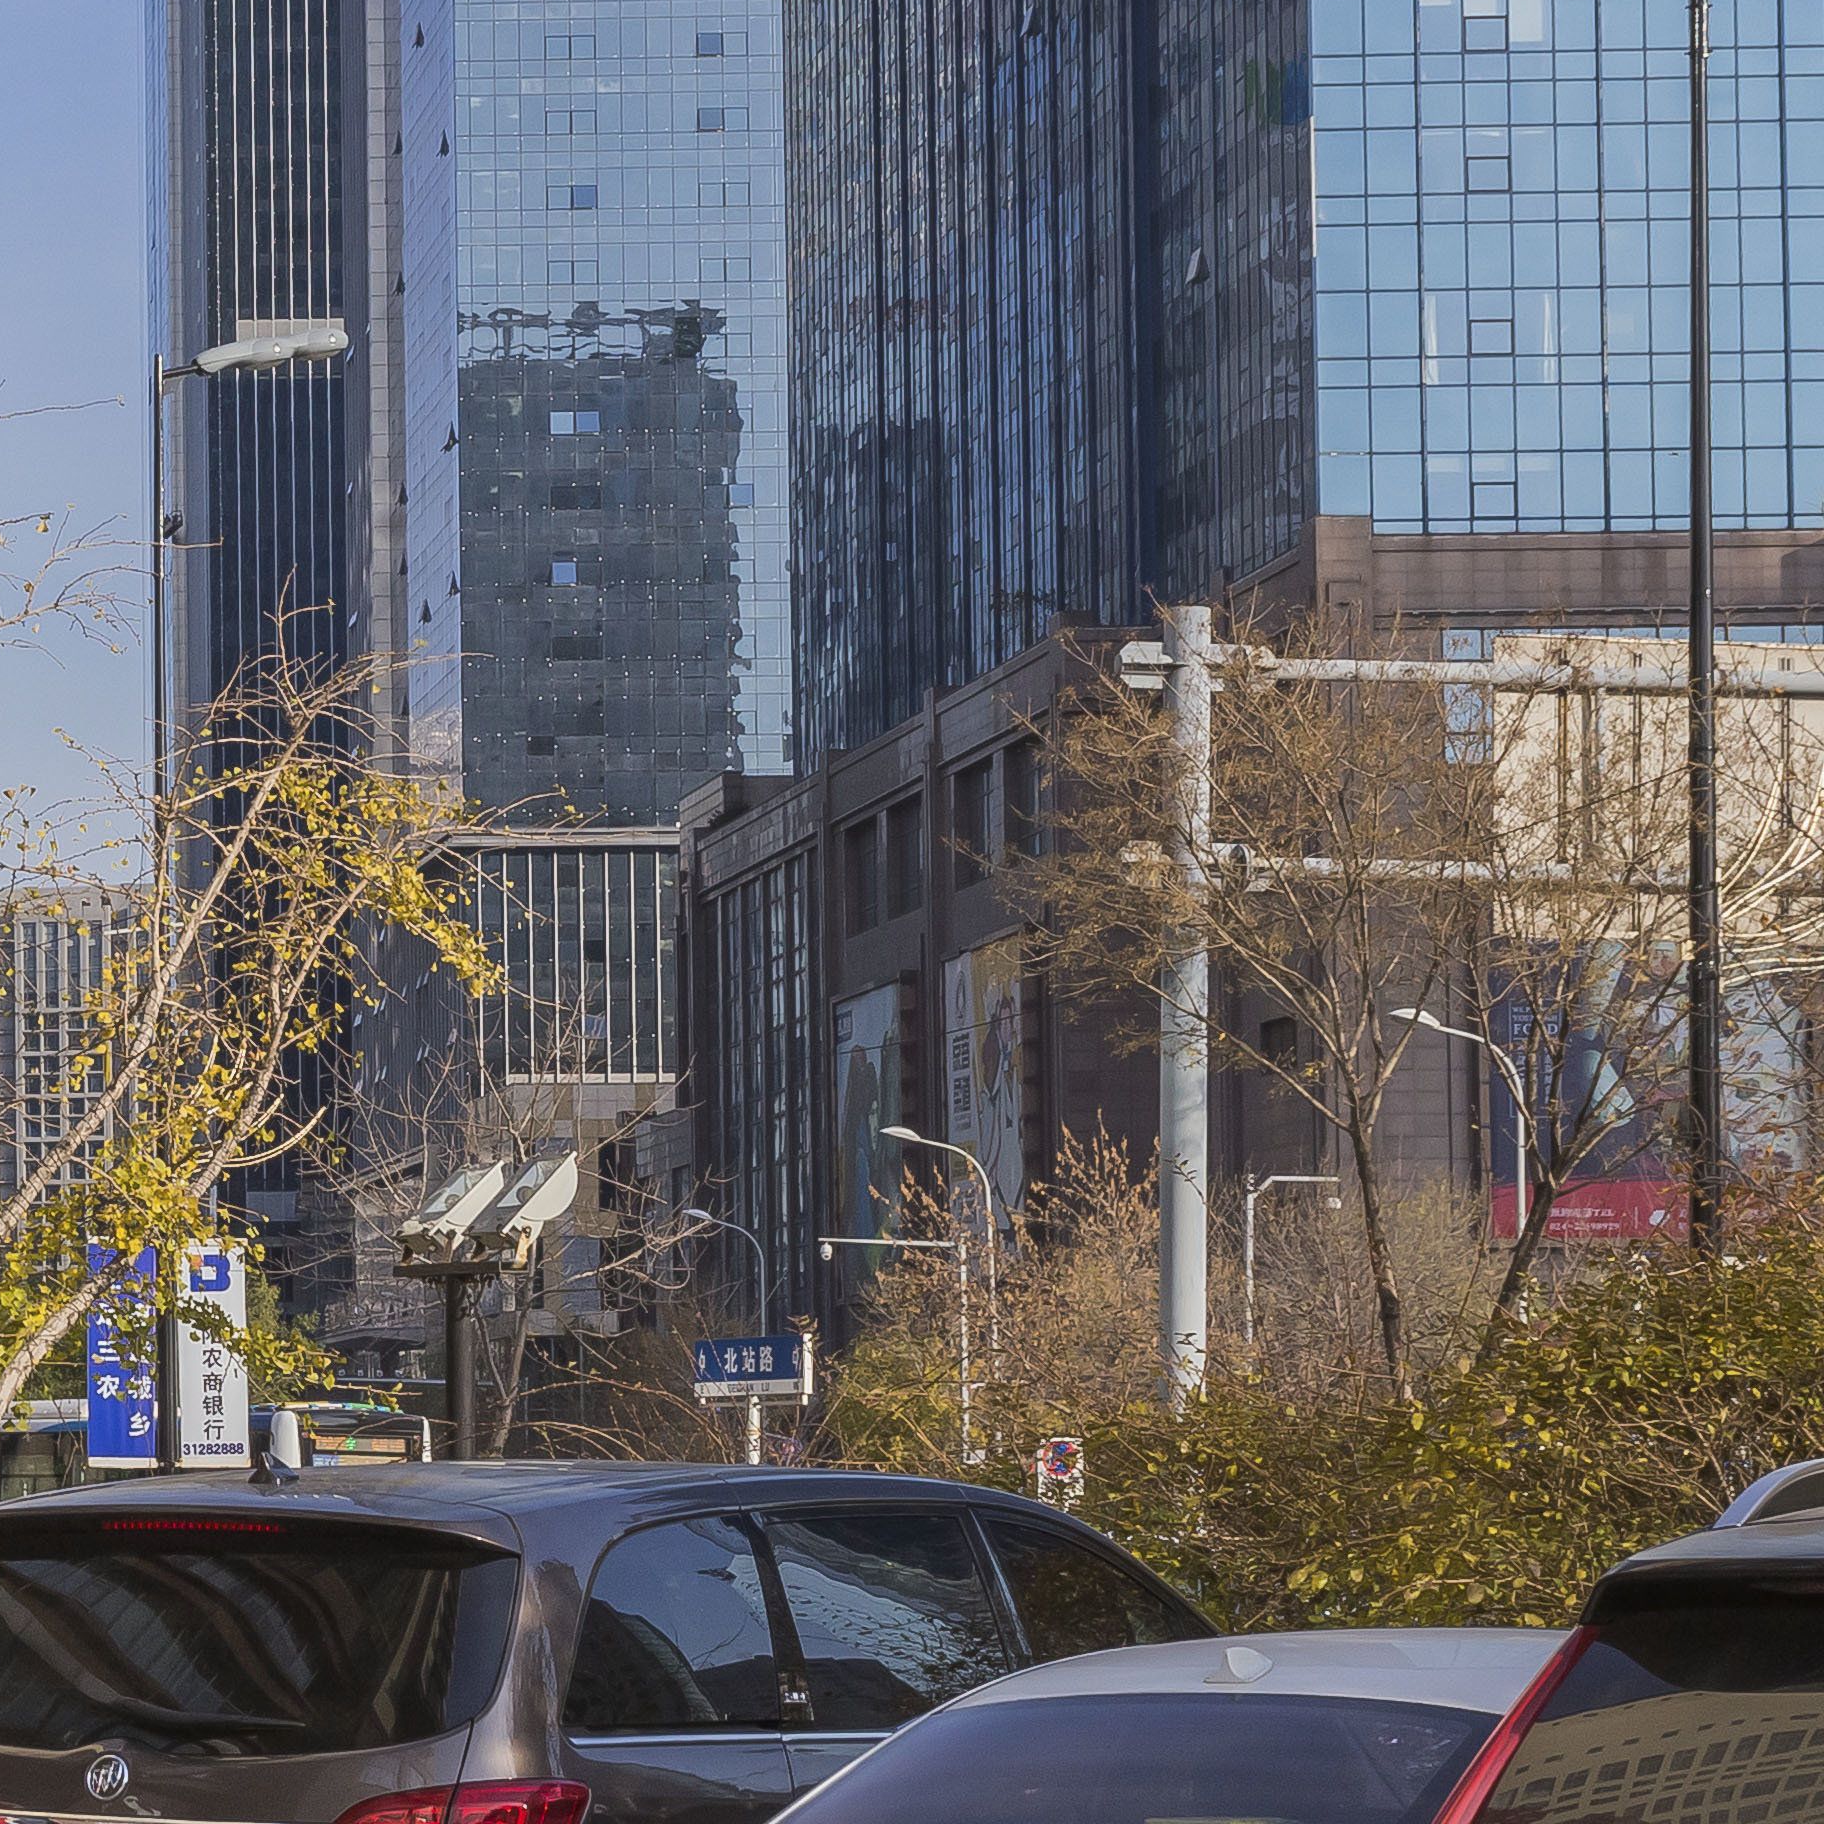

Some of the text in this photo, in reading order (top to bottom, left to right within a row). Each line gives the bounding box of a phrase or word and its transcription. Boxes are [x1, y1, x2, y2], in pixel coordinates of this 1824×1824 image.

[1513, 1023, 1558, 1035] FOD
[724, 1345, 773, 1373] 北站路
[183, 1443, 245, 1456] 31282888
